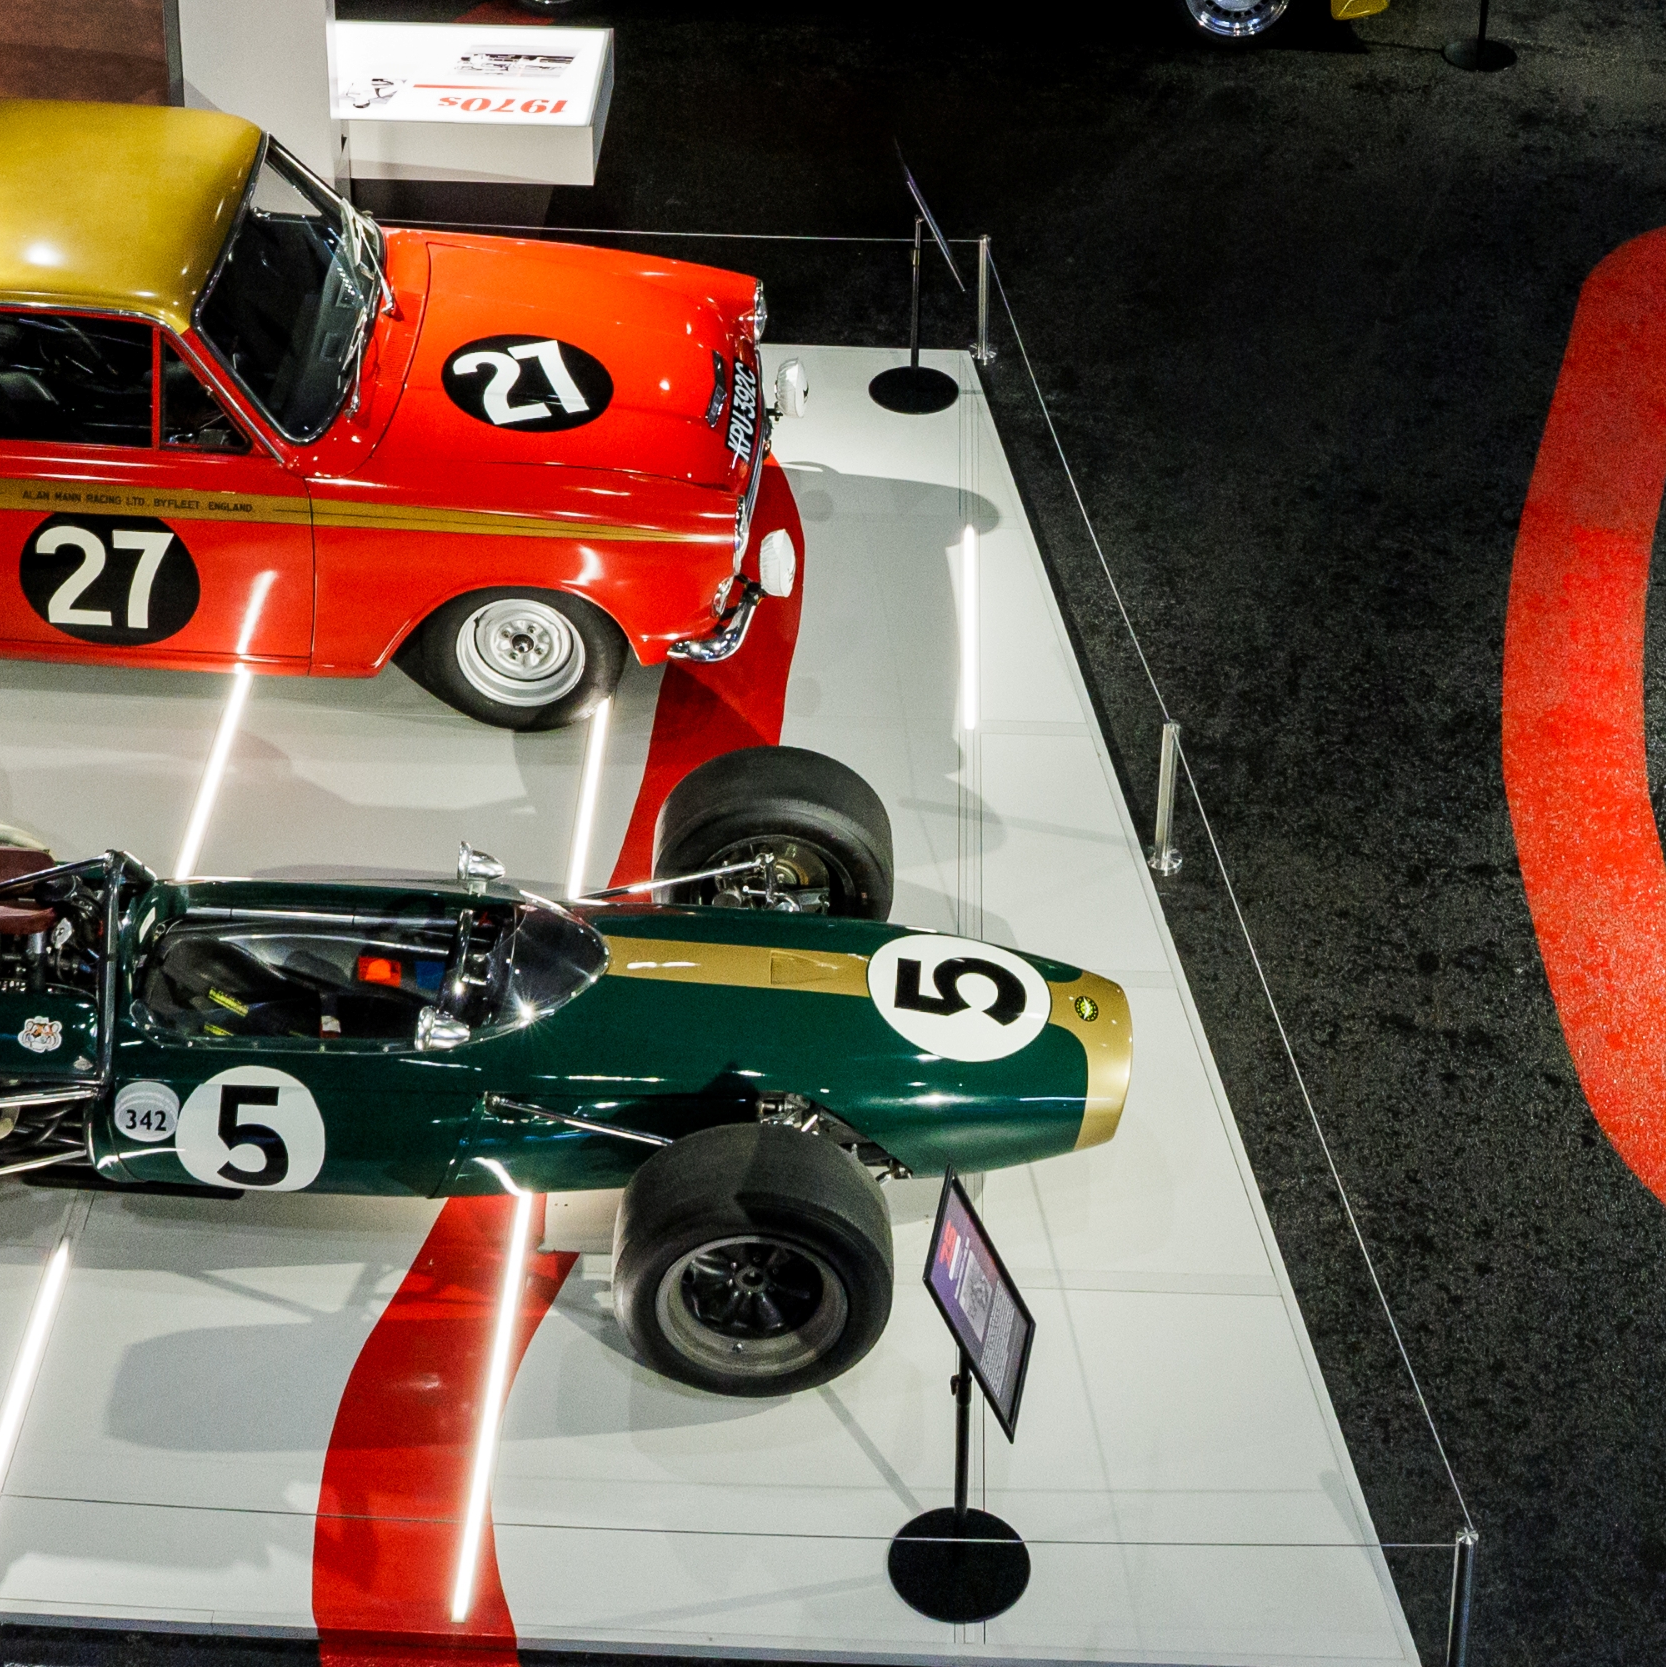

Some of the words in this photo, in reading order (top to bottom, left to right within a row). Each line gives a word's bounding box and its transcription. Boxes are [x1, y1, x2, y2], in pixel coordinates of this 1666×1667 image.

[437, 96, 569, 115] 1970s
[452, 339, 590, 427] 27
[732, 362, 756, 414] 392C
[728, 406, 758, 465] KPU
[22, 489, 50, 502] ALAN
[54, 491, 82, 503] MANN
[86, 493, 122, 506] RACING
[153, 497, 200, 511] BYFLEET
[33, 523, 175, 630] 27
[893, 956, 1028, 1028] 5
[125, 1108, 168, 1133] 342
[217, 1084, 289, 1186] 5
